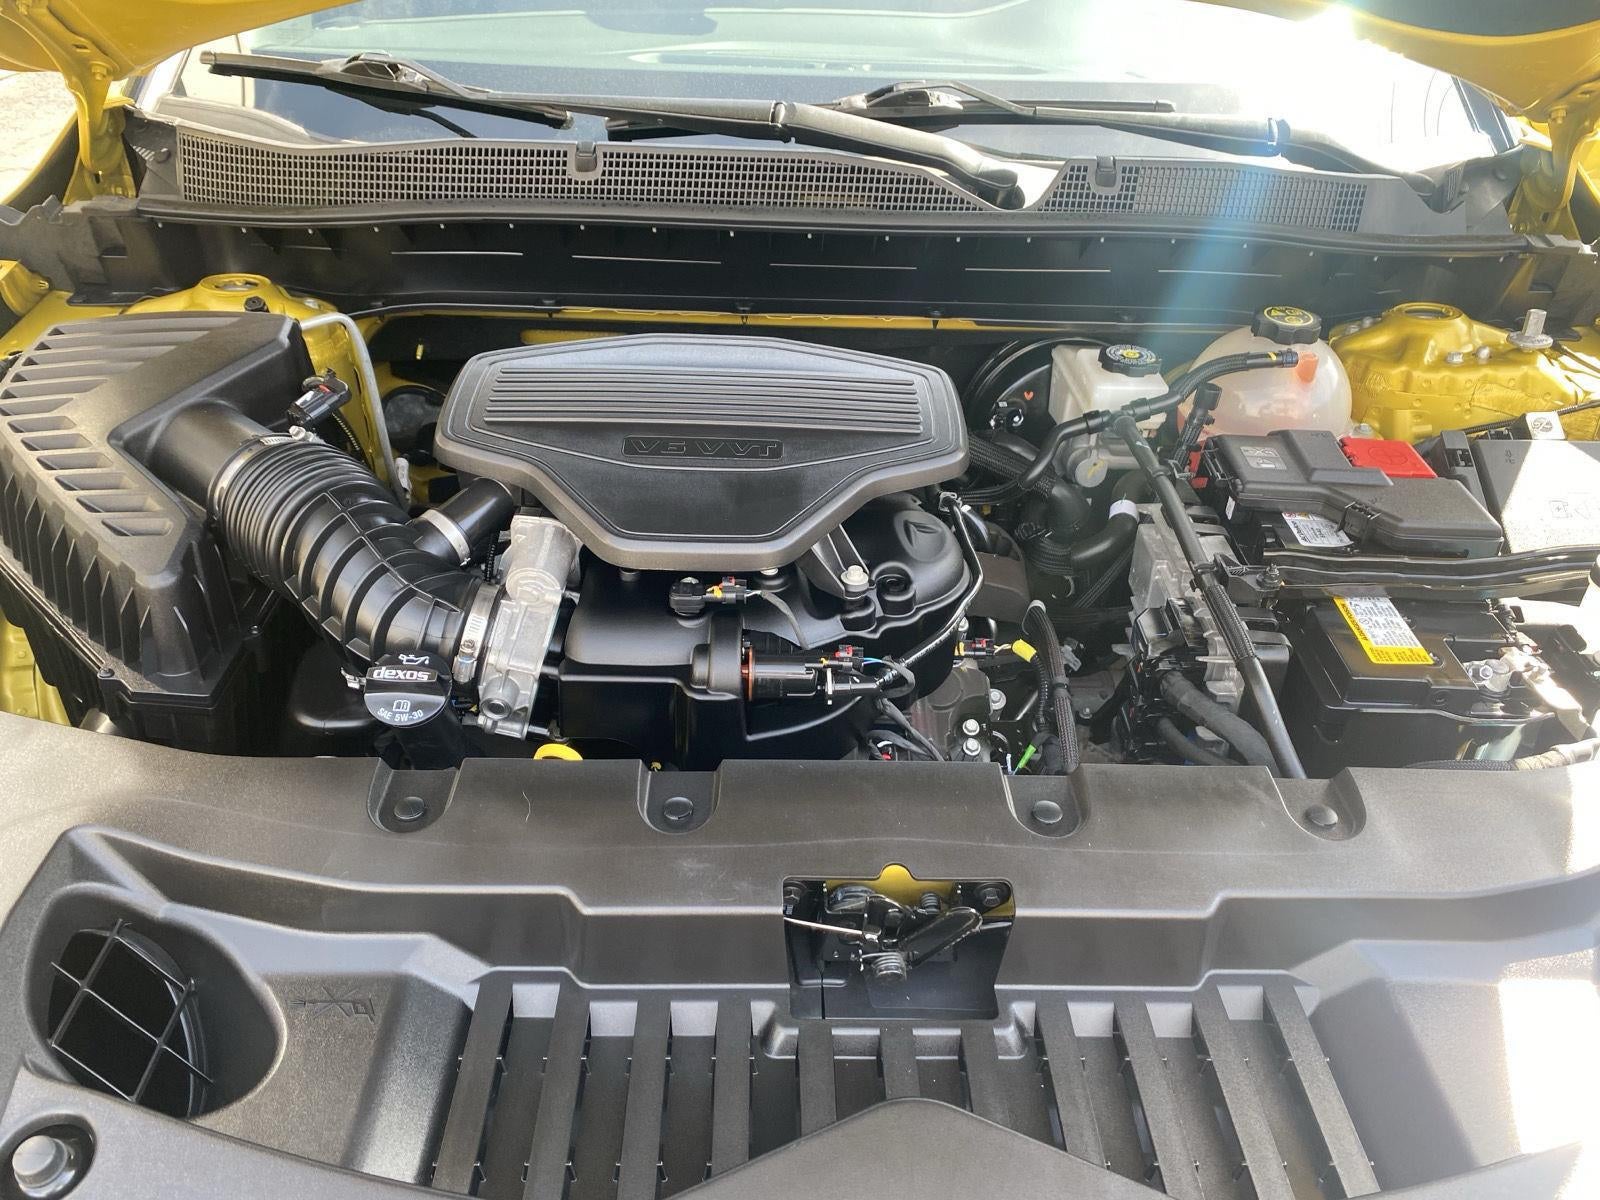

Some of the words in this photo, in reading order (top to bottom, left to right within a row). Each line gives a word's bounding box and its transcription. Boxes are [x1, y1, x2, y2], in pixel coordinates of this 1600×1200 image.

[694, 440, 778, 457] VVT
[373, 667, 431, 681] dexos
[378, 708, 392, 719] SAE
[395, 709, 423, 721] 5W-30
